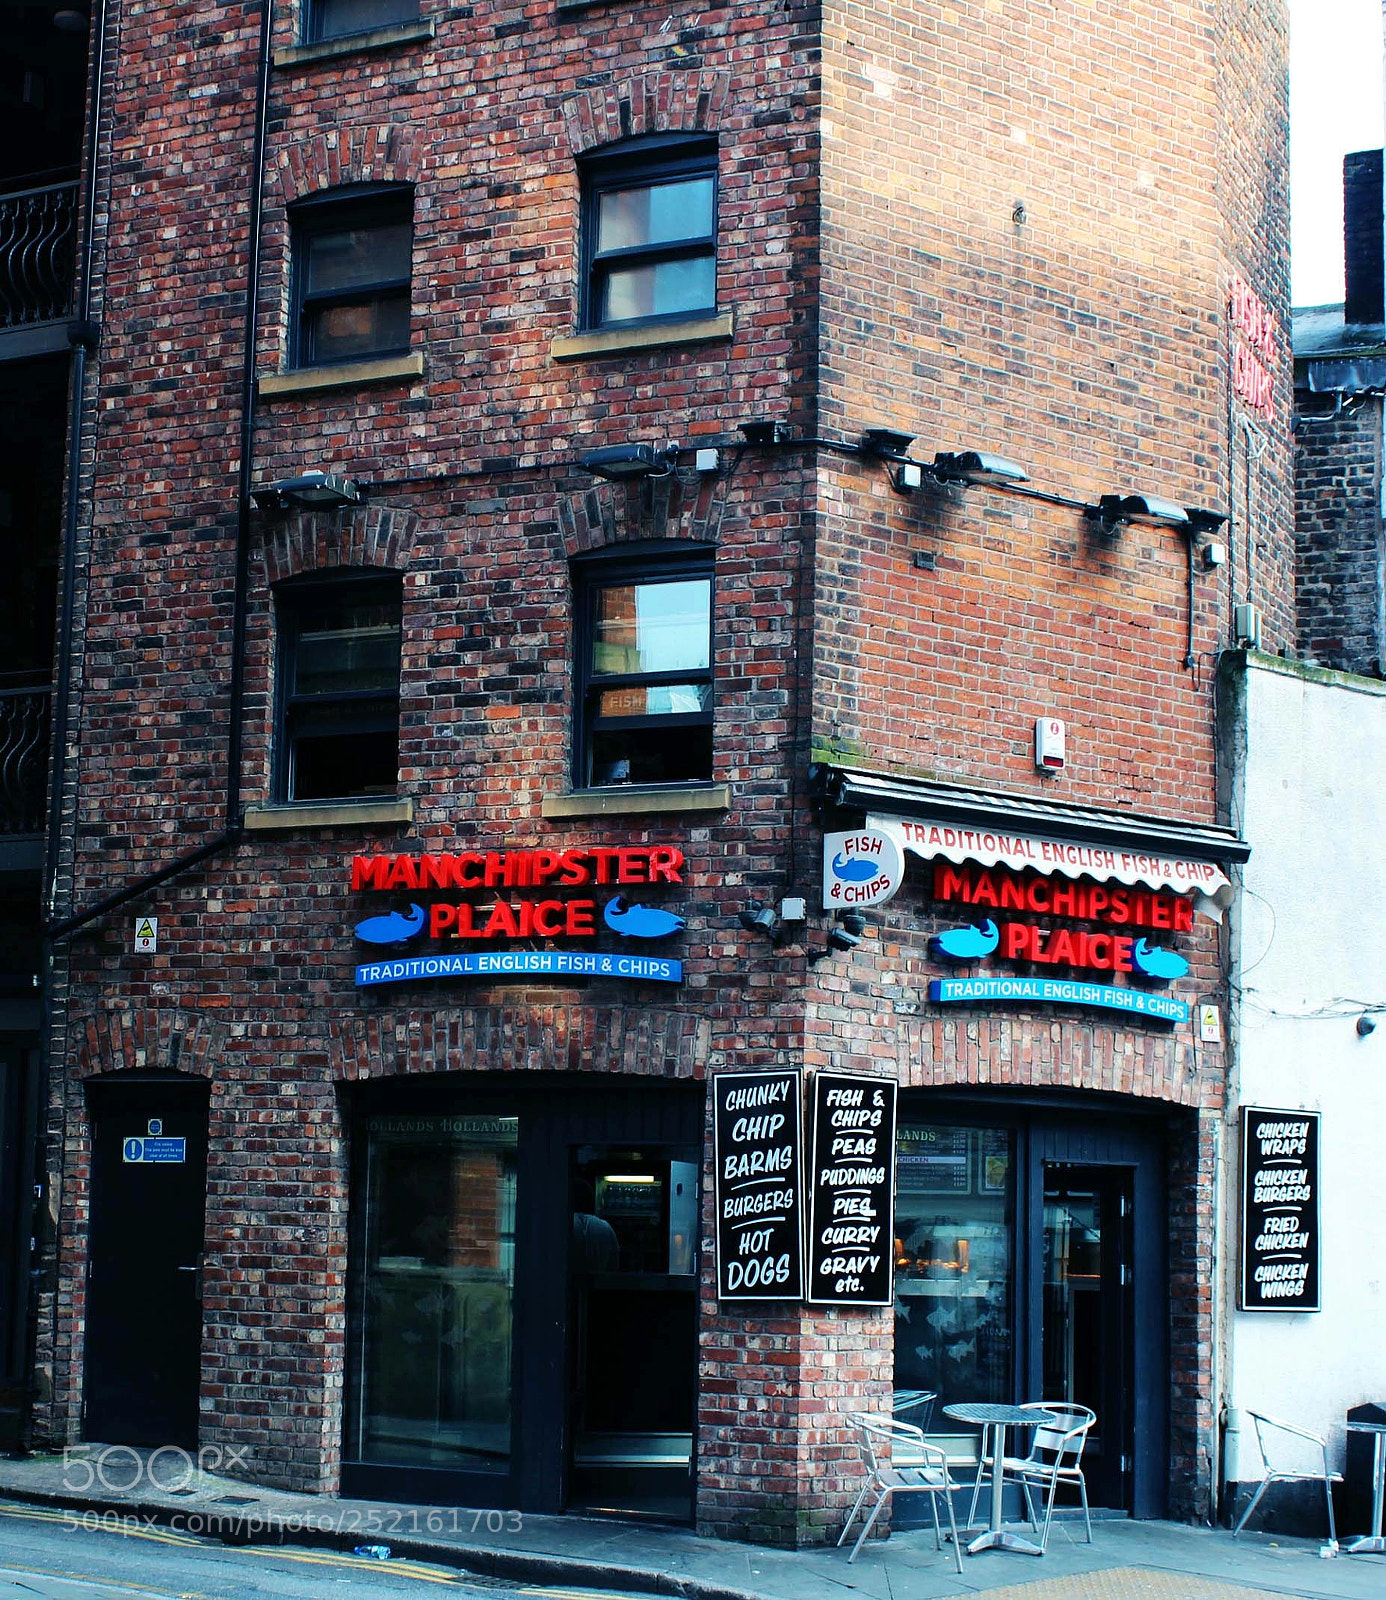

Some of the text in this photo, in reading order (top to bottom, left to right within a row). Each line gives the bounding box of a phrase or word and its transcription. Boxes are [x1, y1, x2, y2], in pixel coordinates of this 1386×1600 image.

[1234, 341, 1275, 423] CHIPS
[609, 693, 643, 708] FISH
[844, 836, 883, 855] FISH
[902, 822, 1228, 881] TRADITIONAL ENGLISH FISH & CHIP
[351, 846, 684, 890] MANCHIPSTER
[831, 874, 891, 902] & CHIPS
[933, 864, 1193, 932] MANCHIPSTER
[430, 900, 598, 939] PLAICE
[1001, 922, 1134, 972] PLAICE
[360, 955, 671, 982] TRADITIONAL ENGLISH FISH & CHIPS
[945, 981, 1185, 1019] TRADITIONAL ENGLISH FISH & CHIPS
[725, 1080, 790, 1111] CHUNKY
[826, 1090, 885, 1107] FISH &
[732, 1113, 785, 1142] CHIP
[831, 1110, 882, 1127] CHIPS
[896, 1130, 936, 1142] LANDS
[1256, 1122, 1309, 1139] CHICKEN
[831, 1138, 877, 1155] PEAS
[1260, 1138, 1307, 1156] WRAPS
[724, 1146, 792, 1179] BARMS
[820, 1167, 885, 1186] PUDDINGS
[1254, 1169, 1308, 1186] CHICKEN
[724, 1189, 793, 1218] BURGERS
[1254, 1185, 1311, 1203] BURGERS
[833, 1197, 873, 1216] PIES
[1264, 1217, 1299, 1234] FRIED
[739, 1228, 774, 1255] HOT
[821, 1226, 880, 1245] CURRY
[1255, 1233, 1309, 1251] CHICKEN
[728, 1254, 790, 1290] DOGS
[820, 1256, 880, 1275] GRAVY
[1254, 1263, 1309, 1282] CHICKEN
[835, 1275, 865, 1293] etc.
[1260, 1280, 1304, 1299] WINGS
